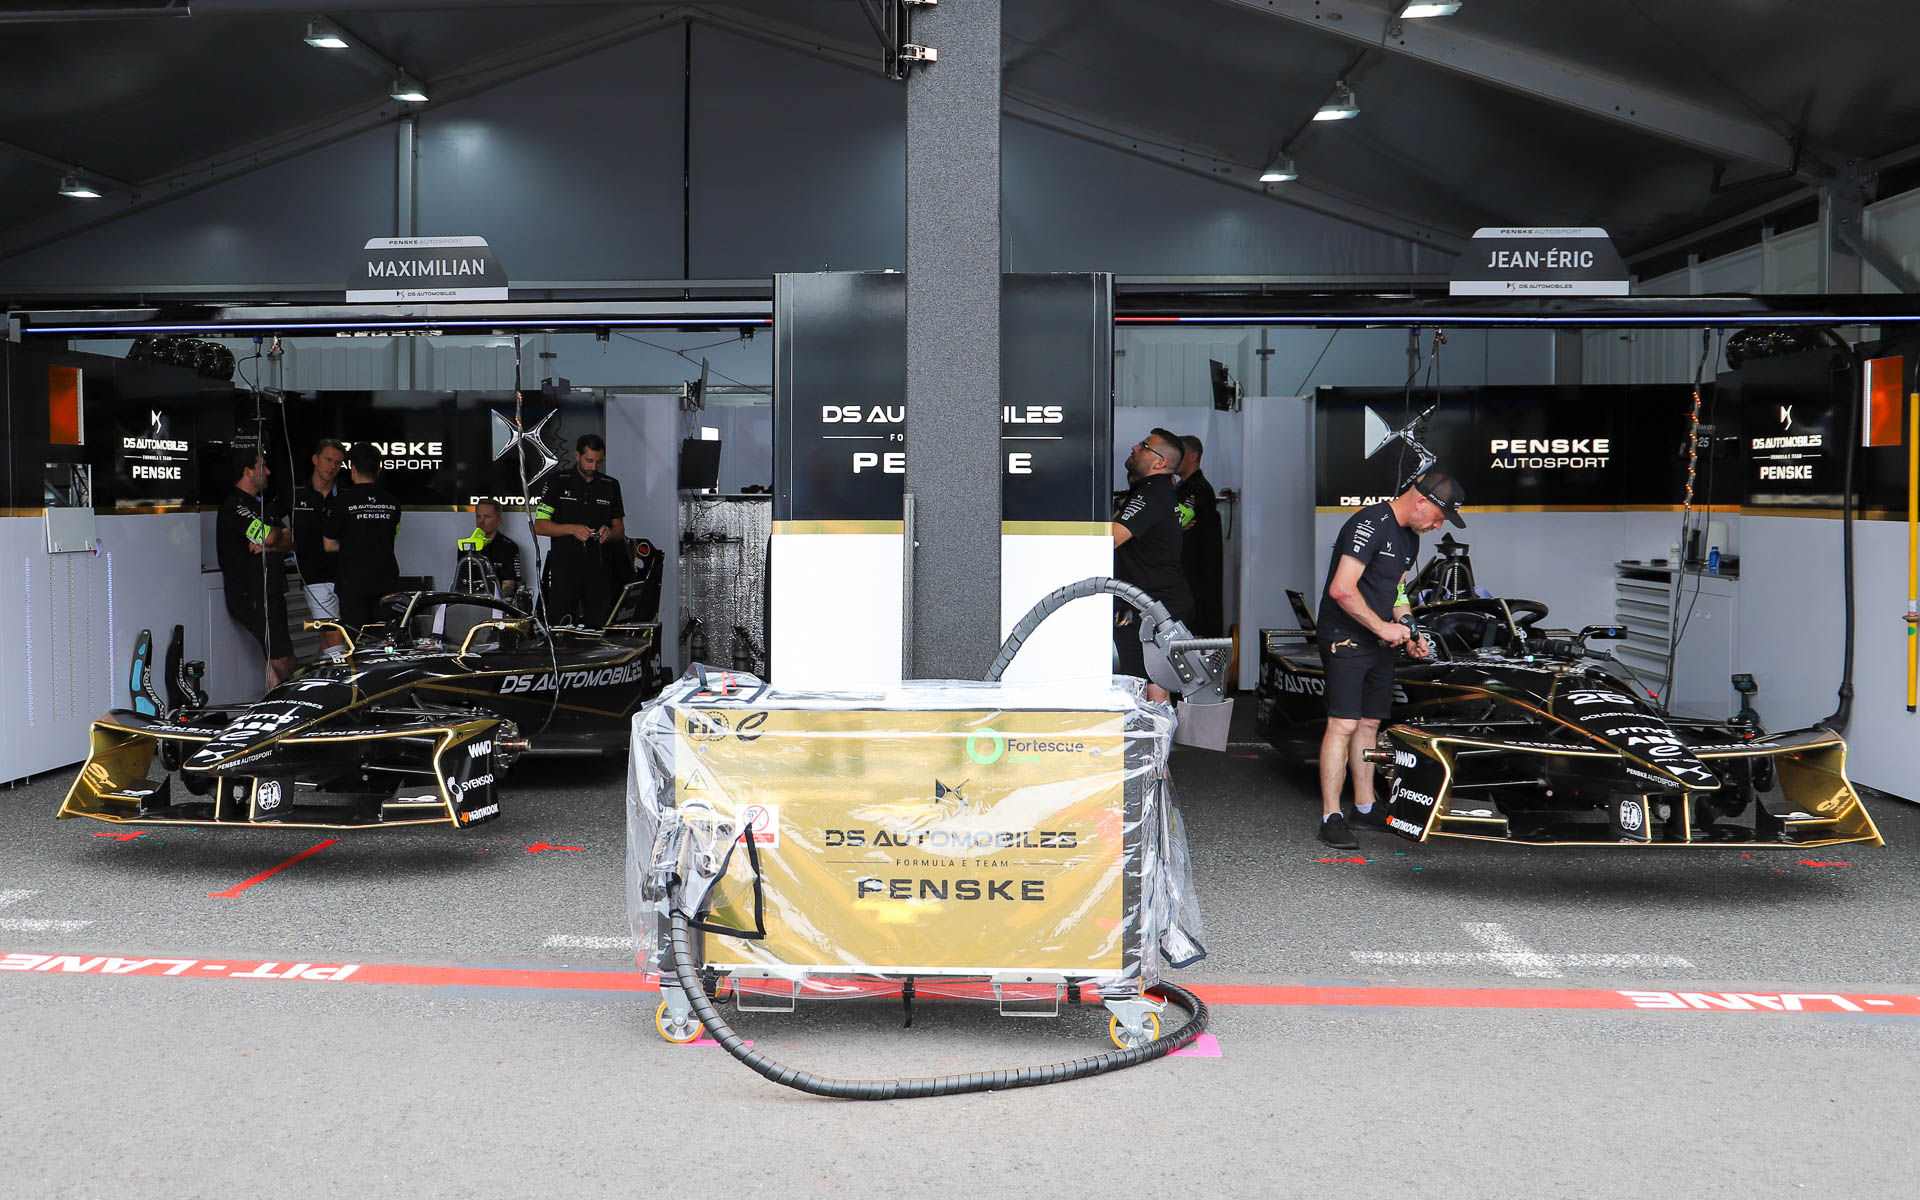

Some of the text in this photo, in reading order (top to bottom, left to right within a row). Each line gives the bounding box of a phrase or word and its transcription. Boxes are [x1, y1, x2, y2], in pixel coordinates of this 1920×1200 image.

[1488, 248, 1594, 268] JEAN-ÉRIC
[368, 259, 485, 277] MAXIMILIAN
[822, 405, 1064, 424] DS AUILES
[123, 437, 189, 451] DS AUTOMOBILES
[340, 442, 443, 456] PNSKE
[1491, 439, 1610, 454] PENSKE
[1752, 435, 1822, 449] DS AUTOMOBILES
[340, 460, 443, 470] ASPORT
[852, 452, 1032, 474] PEE
[1491, 457, 1610, 469] AUTOSPORT
[132, 465, 182, 480] PENSKE
[1760, 465, 1813, 480] PENSKE
[1340, 496, 1361, 506] DS
[500, 660, 643, 694] DS AUTOMOBILES
[1567, 693, 1634, 705] 25
[1579, 712, 1622, 721] GOLDEN
[1007, 739, 1084, 752] Fortescue
[241, 749, 273, 764] AUTOSPORT
[461, 774, 493, 791] SYENSQO
[1648, 773, 1680, 789] AUTOSPORT
[1399, 788, 1434, 806] SYENSQO
[825, 829, 1078, 849] DS AUTOMOBILES
[896, 858, 1009, 868] FORMULA E TEAM
[857, 878, 1045, 901] PENSKE
